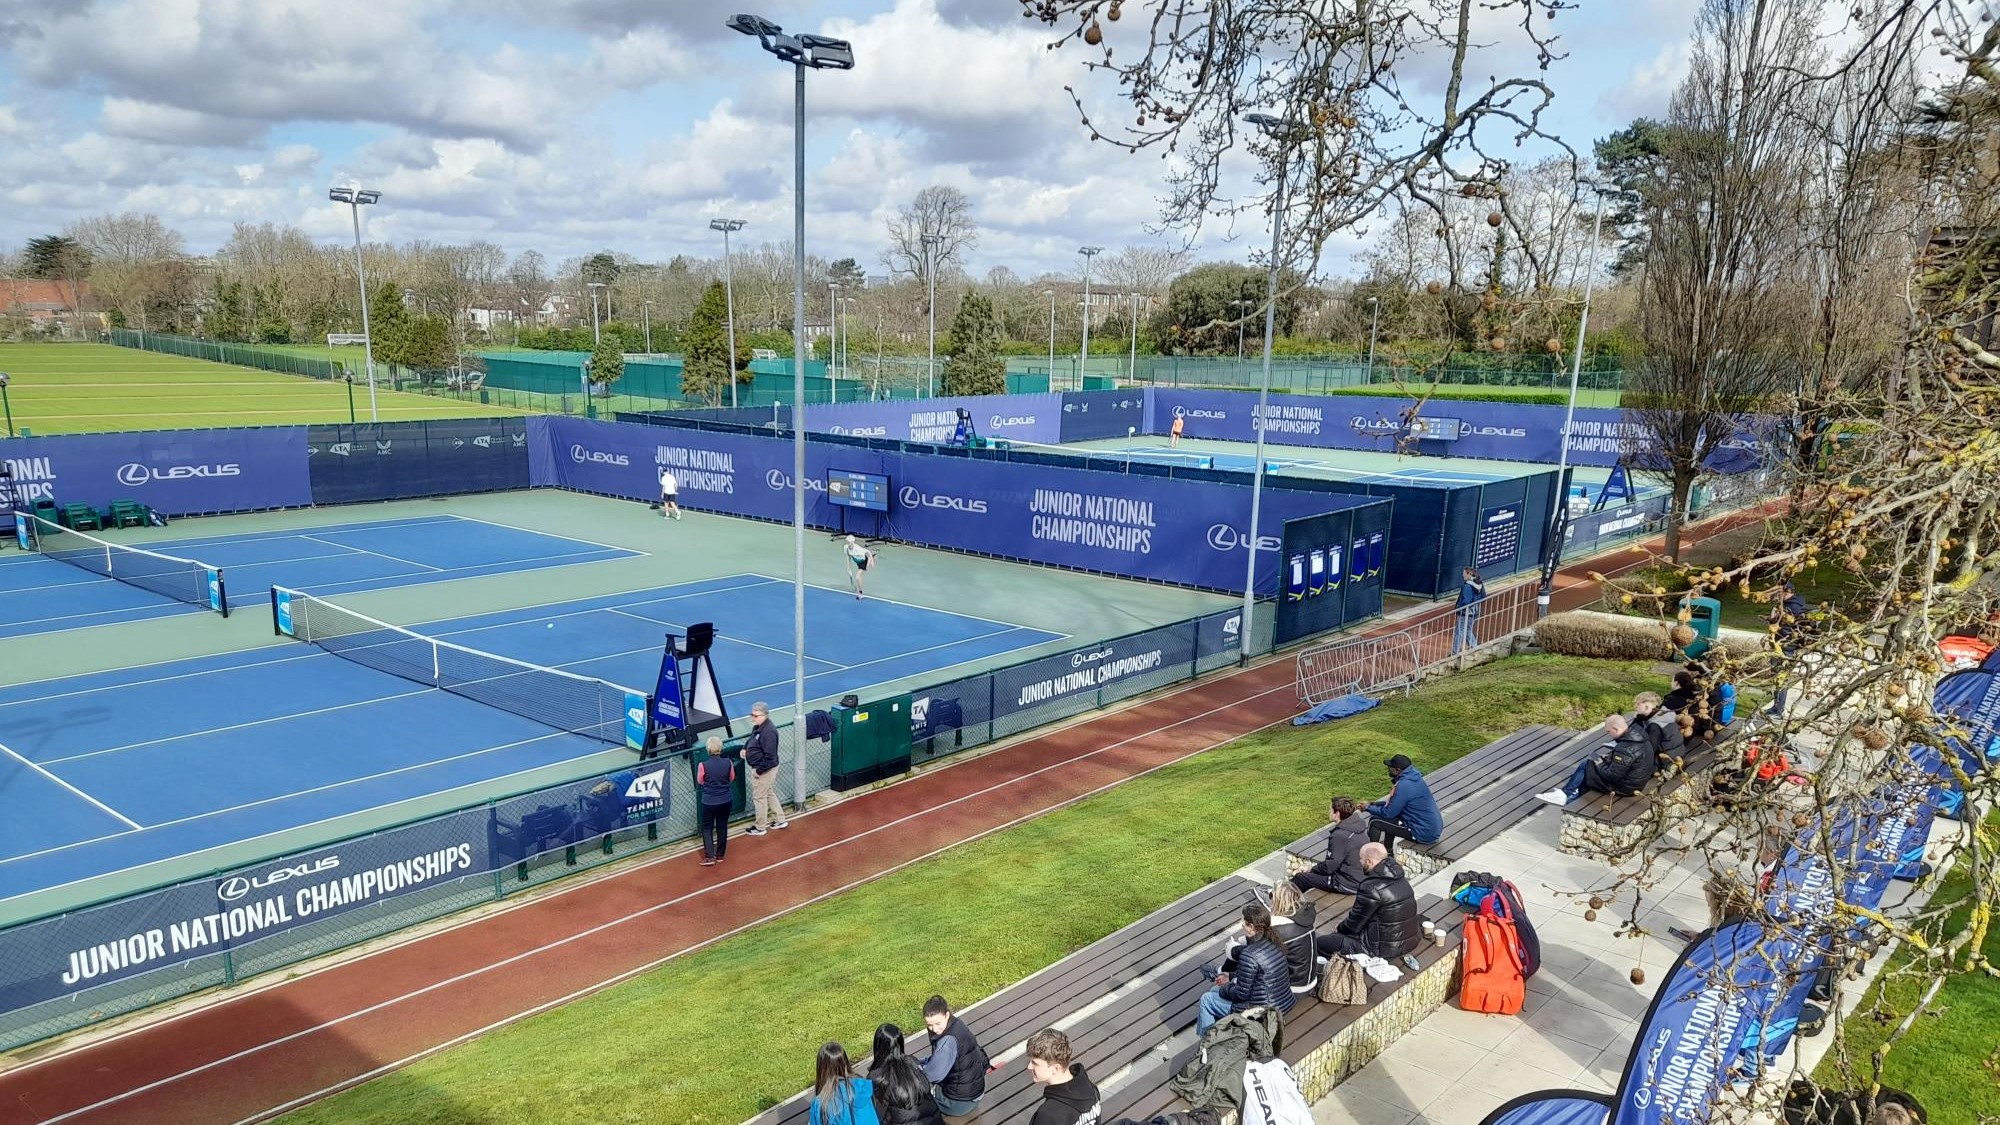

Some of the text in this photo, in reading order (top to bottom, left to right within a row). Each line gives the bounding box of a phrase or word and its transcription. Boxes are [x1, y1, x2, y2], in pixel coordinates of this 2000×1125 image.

[909, 412, 936, 427] JUNIOR
[1002, 416, 1036, 426] LEXUS
[1186, 409, 1226, 419] LEXUS
[1251, 404, 1323, 421] JUIOR NATIONAL
[1252, 417, 1321, 435] CAMPIONSHIPS
[1473, 426, 1526, 437] LEXUS
[586, 450, 629, 466] LEXUS
[655, 445, 735, 473] JUNIOR NATIONAL
[152, 462, 241, 480] LEXUS
[657, 466, 733, 494] CMPIONSHIPS
[785, 475, 828, 492] LXU
[922, 493, 987, 514] LEXUS
[1029, 489, 1156, 527] JUNIOR NATIONAL
[1032, 515, 1152, 554] CHAMPIONSHIPS
[1083, 647, 1114, 662] LEXUS
[1018, 649, 1162, 706] JUNIOR NATIONAL CHAMPIONSHIPS
[626, 798, 664, 814] TENNIS
[252, 855, 340, 889] LEXUS
[62, 843, 472, 985] JUNIOR NATIONAL CHAMPIONSHIPS
[1654, 981, 1726, 1114] JUNIOR NATIONA
